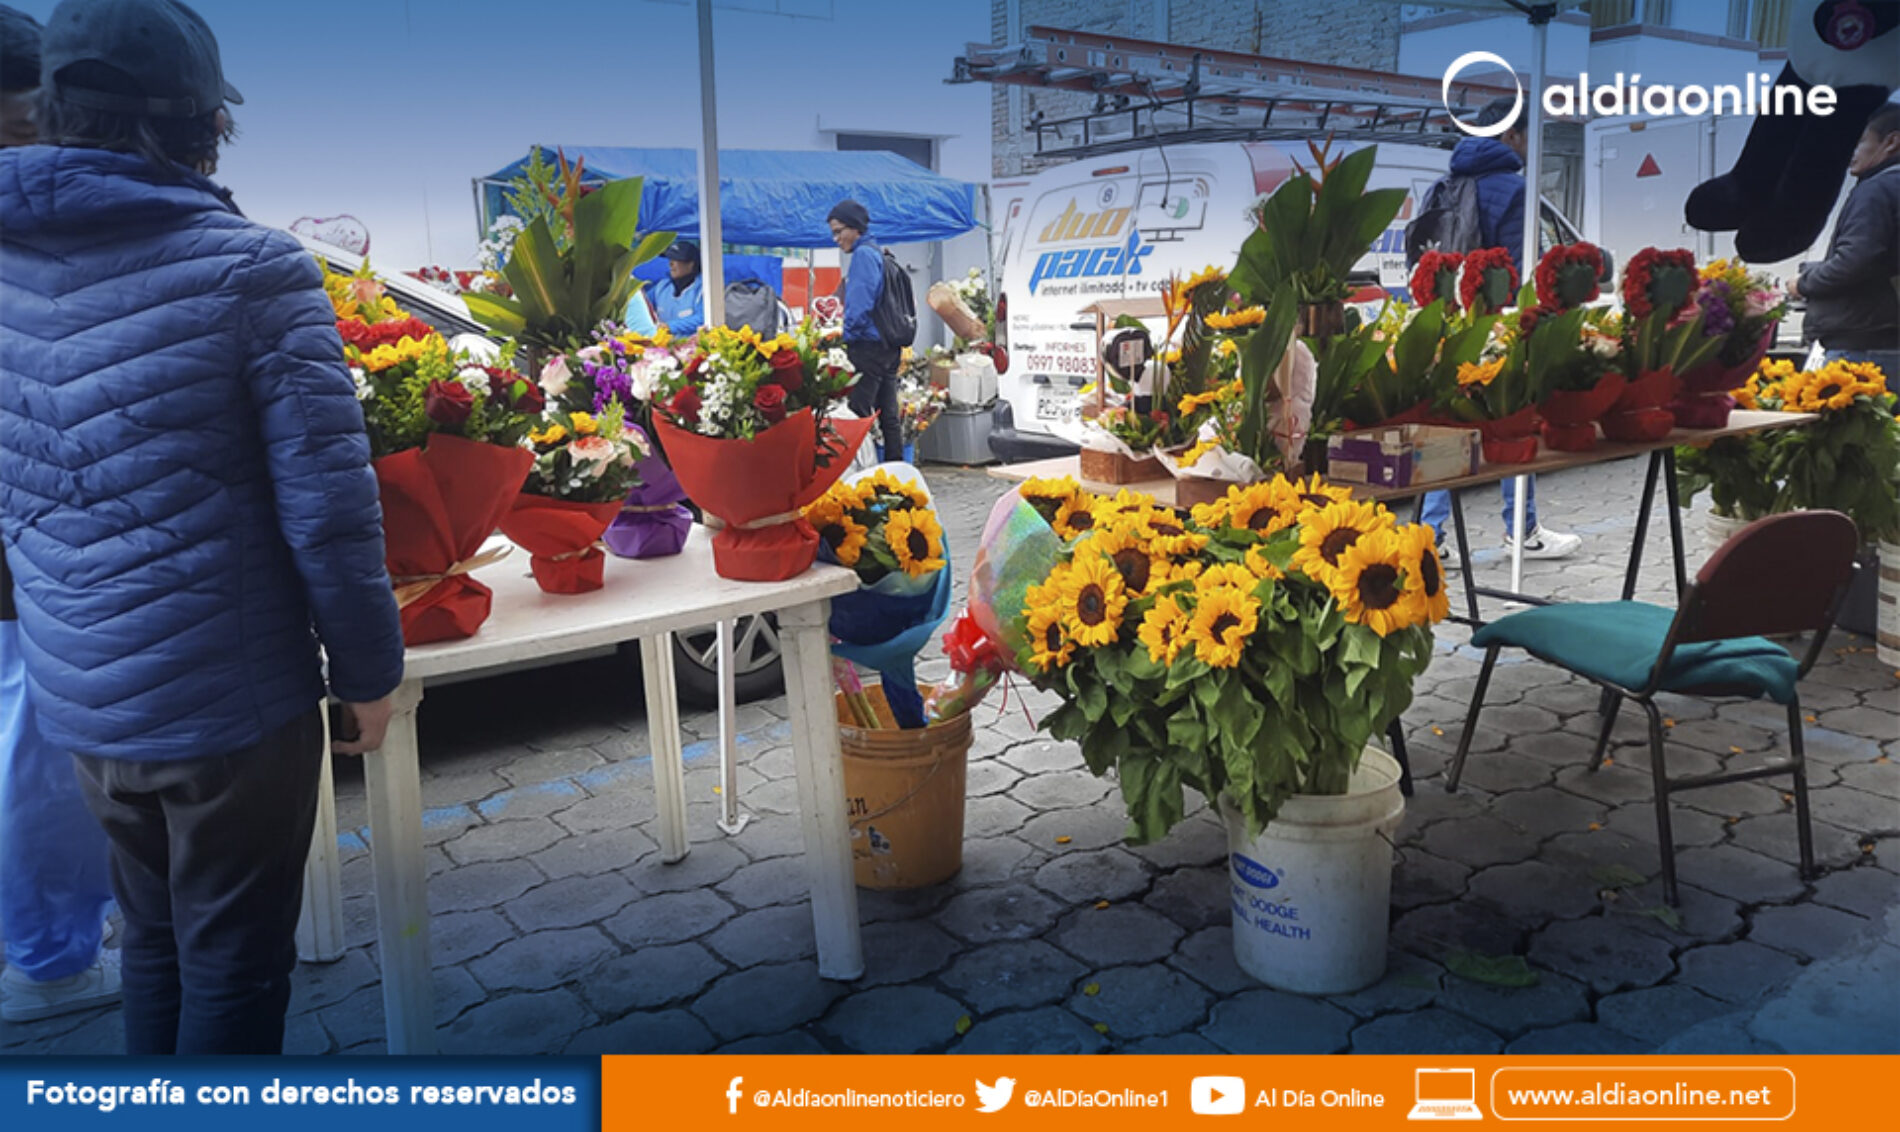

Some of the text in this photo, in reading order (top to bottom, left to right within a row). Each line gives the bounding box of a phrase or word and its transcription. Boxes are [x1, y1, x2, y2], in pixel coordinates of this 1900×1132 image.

[1038, 196, 1133, 243] duo
[1028, 228, 1155, 297] pack
[1136, 279, 1149, 291] tv
[1045, 341, 1087, 353] INFORMES
[1027, 354, 1097, 375] 0997 98083
[1249, 894, 1299, 921] DODGE
[1254, 915, 1311, 940] HEALTH
